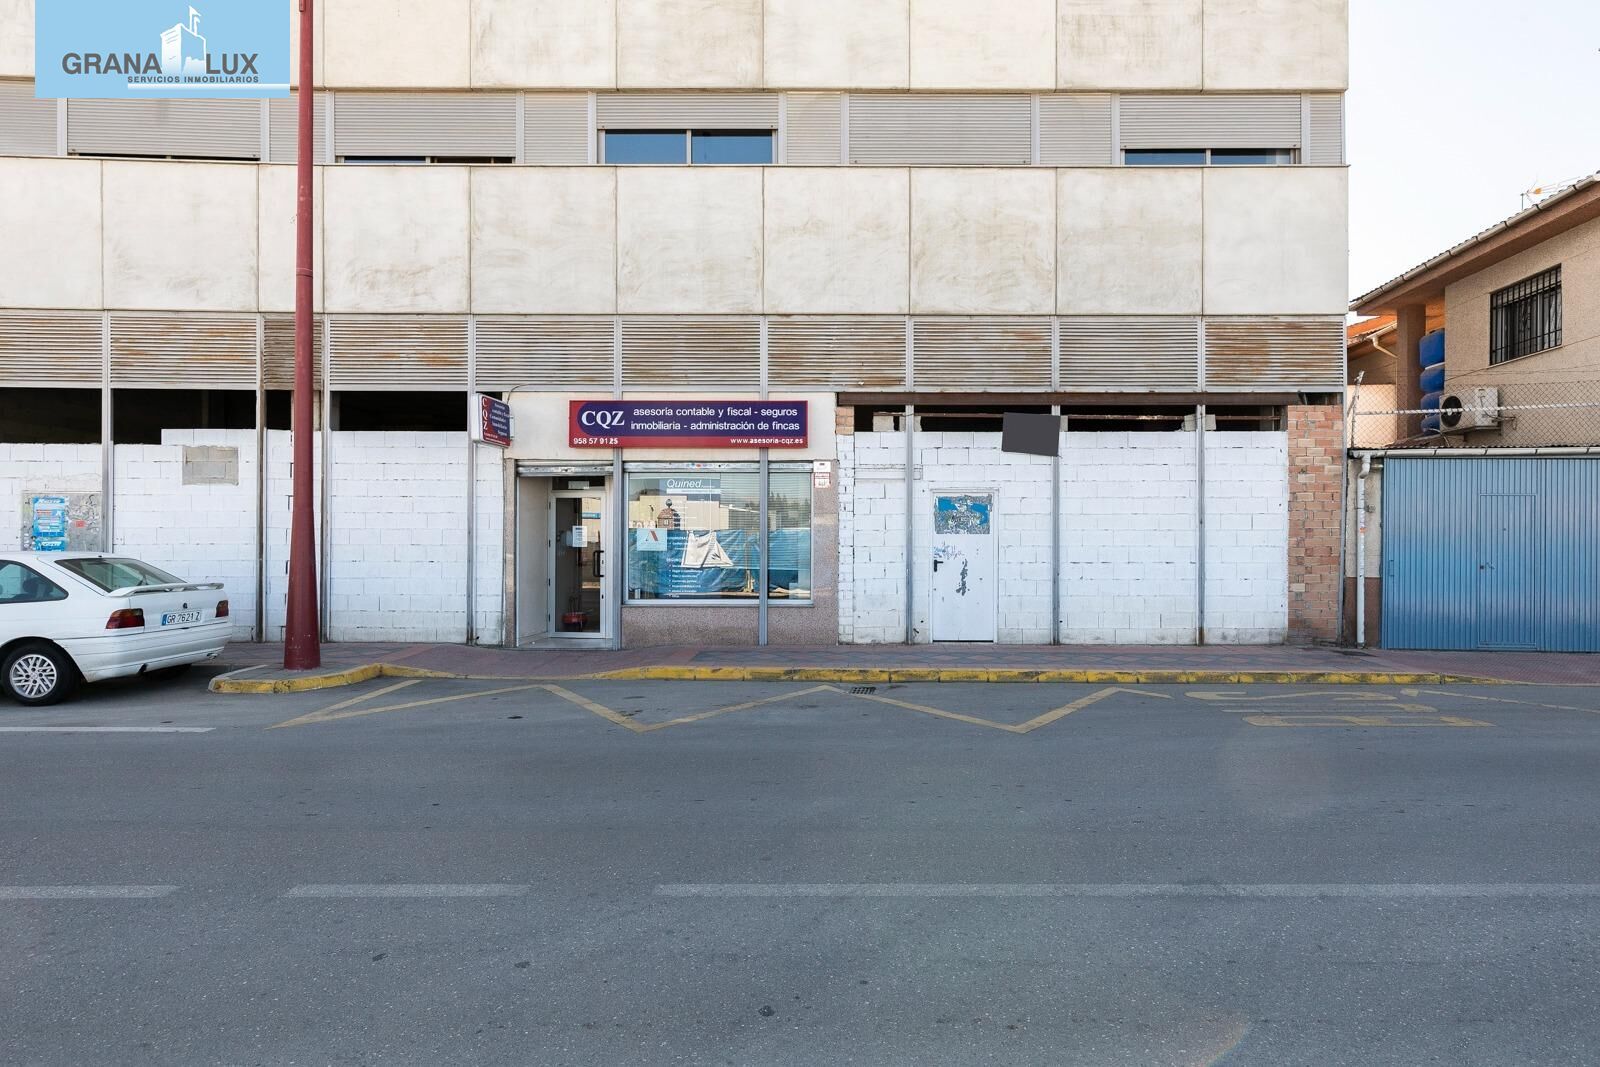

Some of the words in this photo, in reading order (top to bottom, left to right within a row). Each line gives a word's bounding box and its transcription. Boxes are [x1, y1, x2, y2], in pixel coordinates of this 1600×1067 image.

[675, 407, 715, 416] contable
[718, 409, 724, 418] y
[727, 406, 752, 416] fiscal
[761, 408, 798, 418] seguros
[581, 410, 625, 429] CQZ
[631, 420, 681, 430] inmobiliaria
[690, 420, 755, 430] administración
[757, 421, 769, 430] de
[772, 420, 801, 430] fincas
[573, 437, 587, 445] 958
[589, 437, 598, 445] 57
